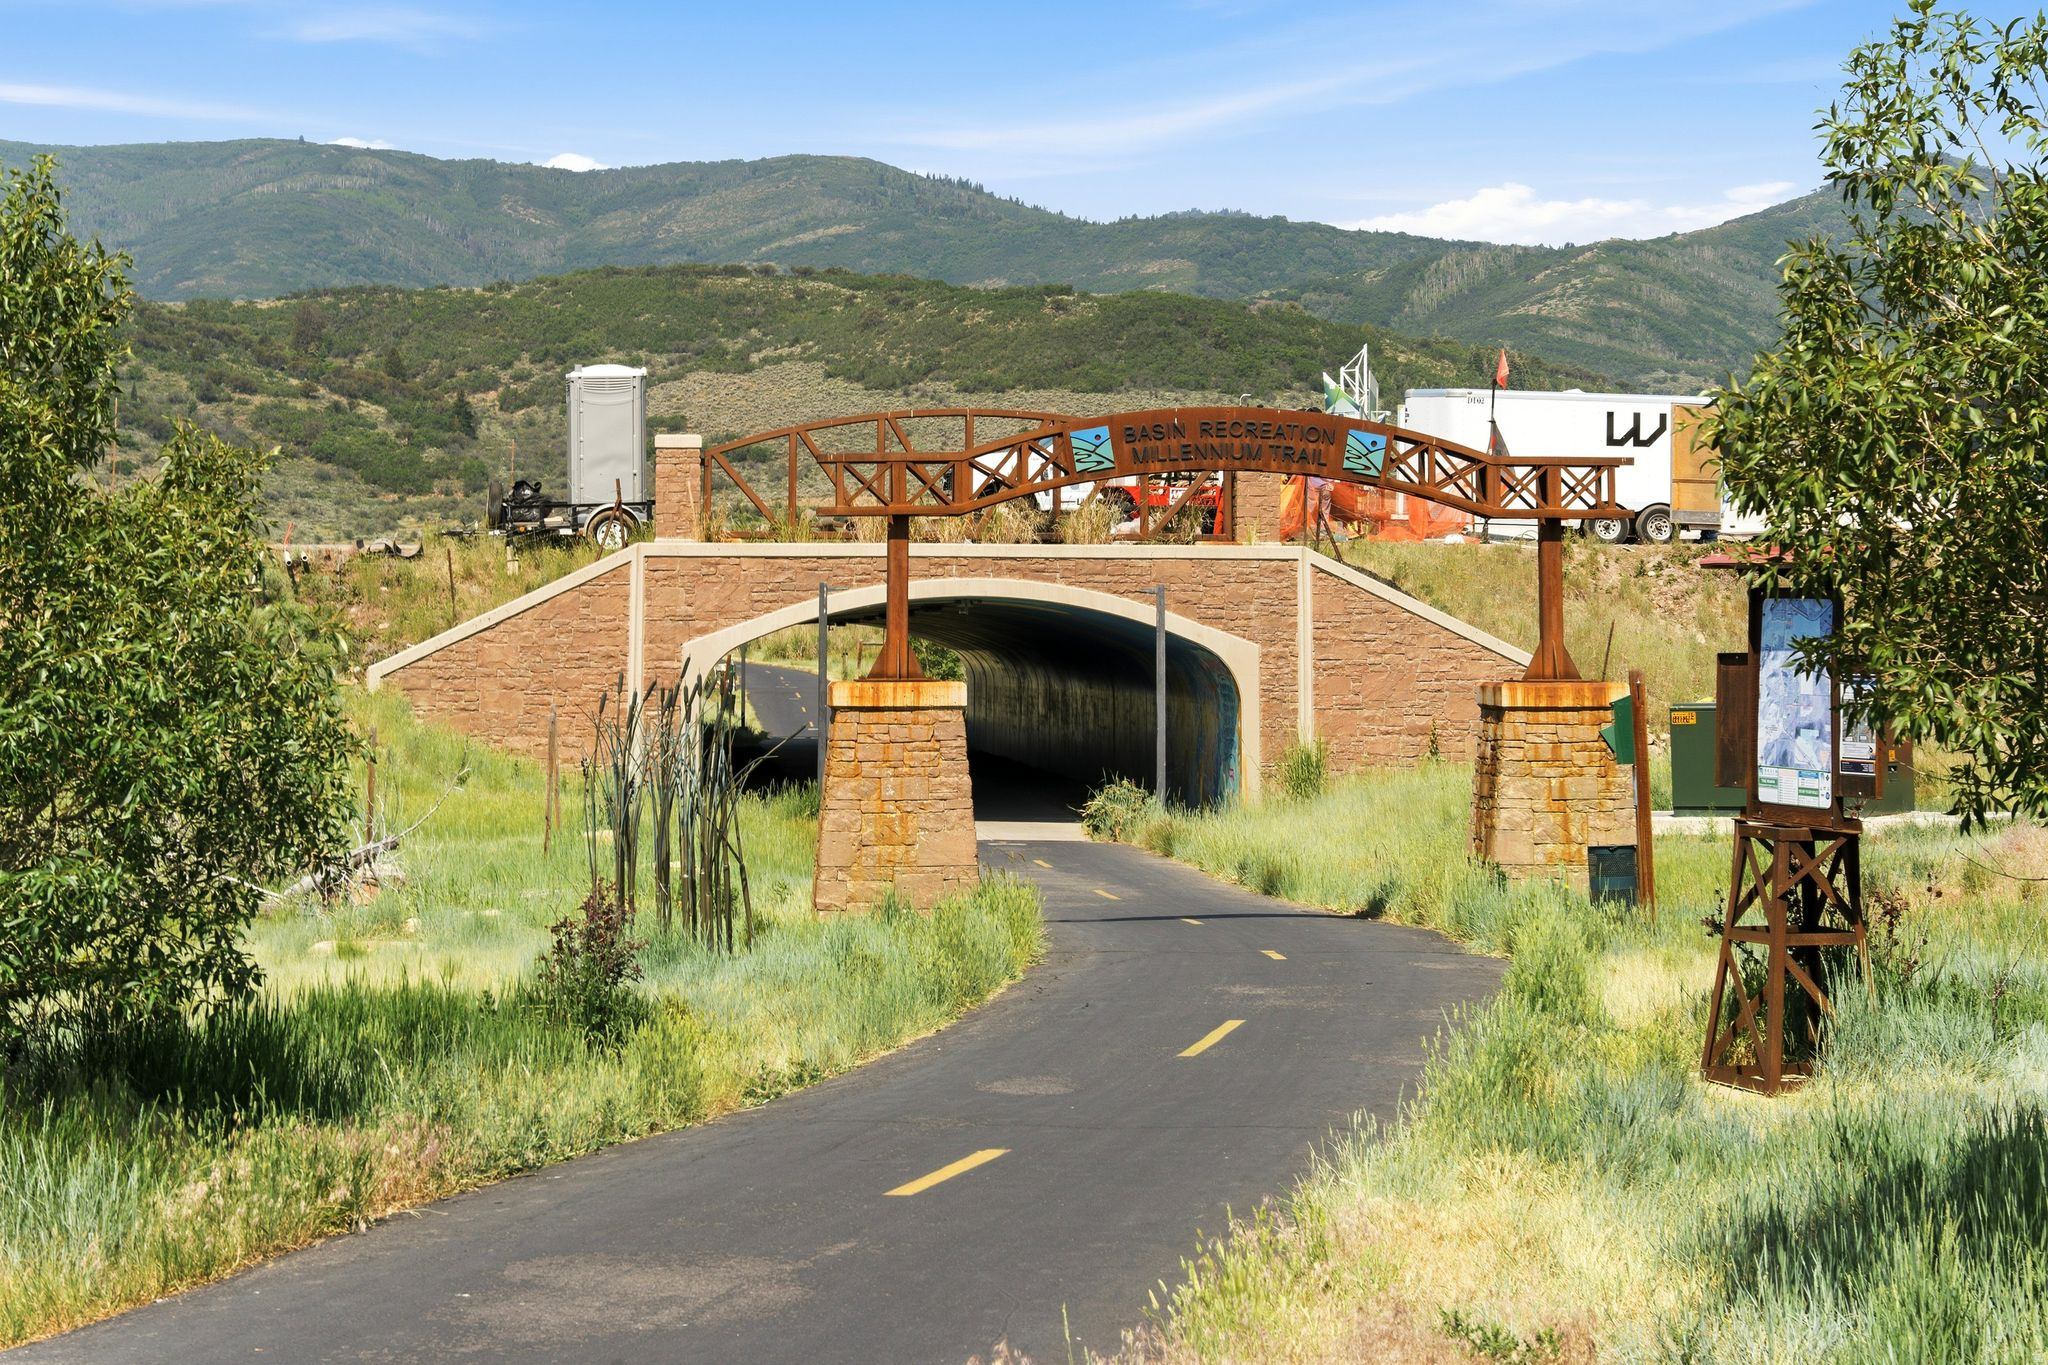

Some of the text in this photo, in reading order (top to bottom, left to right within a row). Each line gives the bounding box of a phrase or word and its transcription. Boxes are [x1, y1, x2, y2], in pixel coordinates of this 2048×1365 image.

[1124, 420, 1336, 446] BASIN RECREATION
[1132, 443, 1328, 467] MILLENNIUM TRAIL
